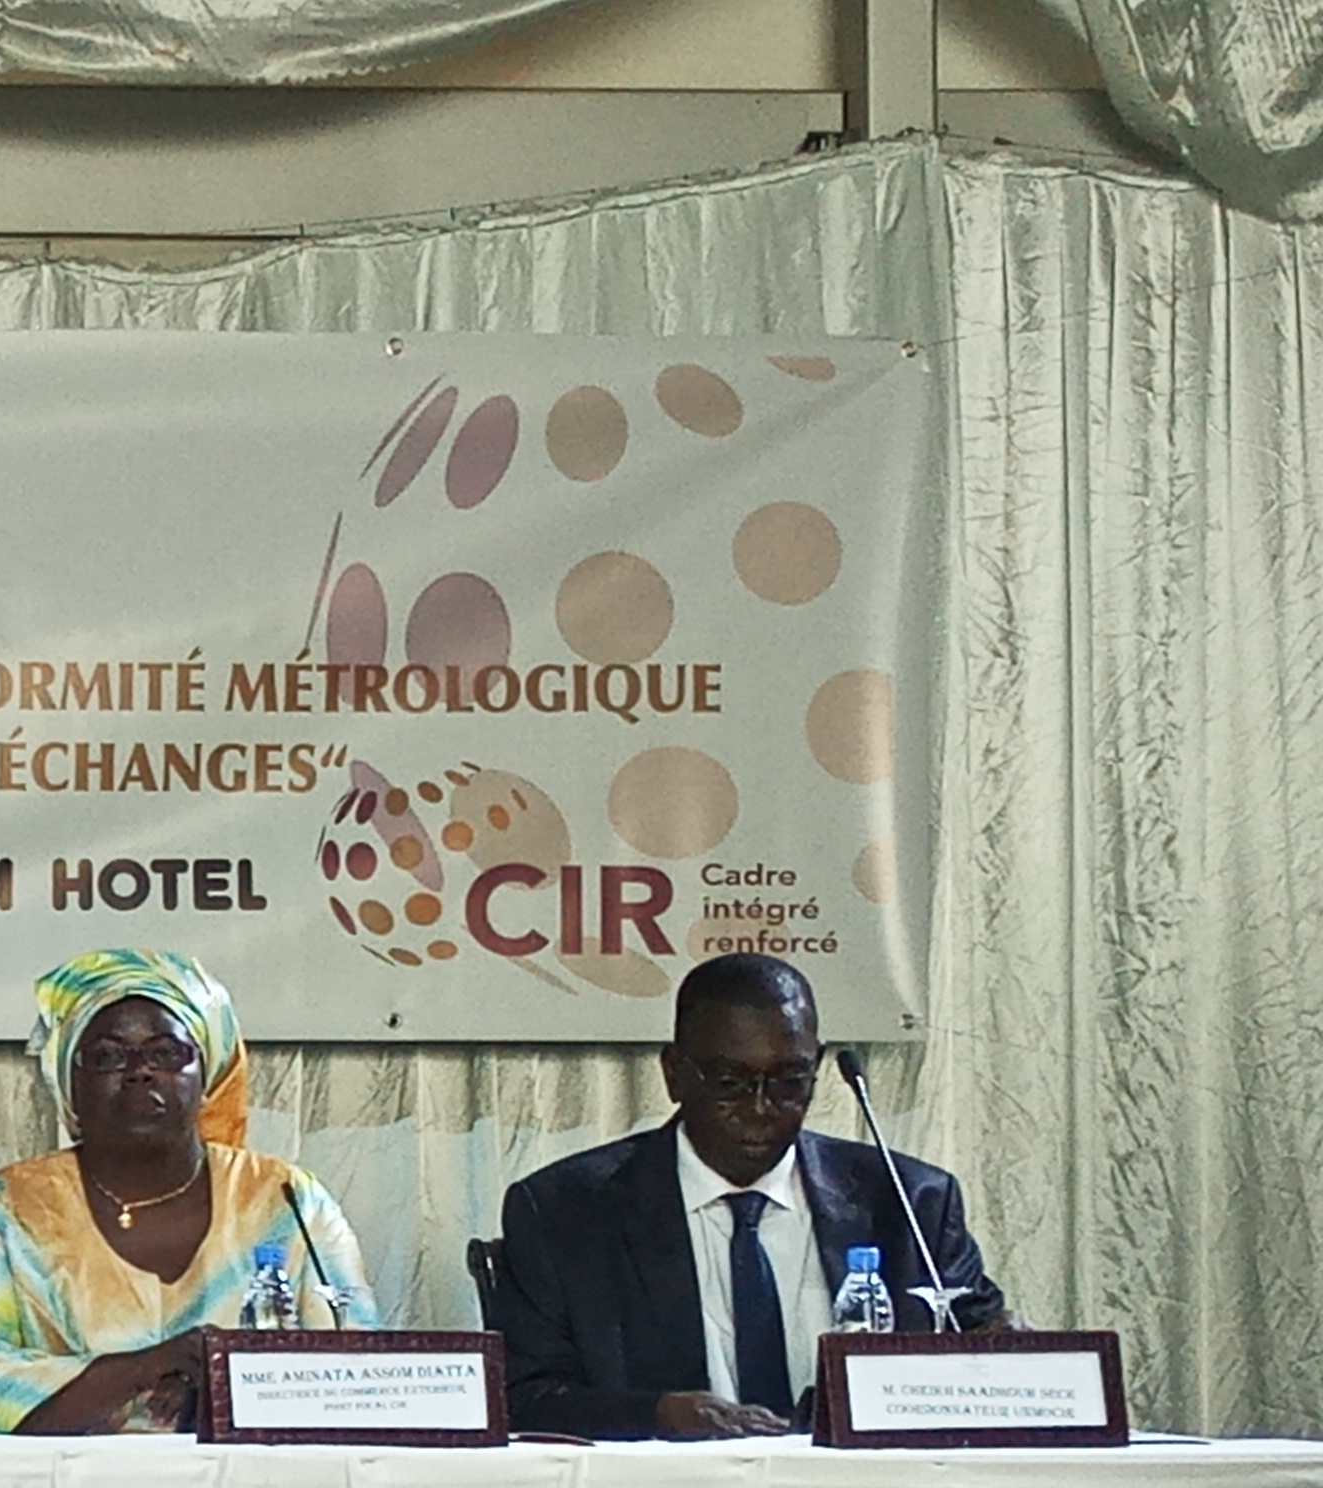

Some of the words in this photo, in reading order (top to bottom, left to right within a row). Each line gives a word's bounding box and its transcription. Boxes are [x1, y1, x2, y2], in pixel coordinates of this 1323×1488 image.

[226, 647, 722, 725] MÉTROLOGIQUE
[54, 860, 268, 911] HOTEL
[700, 863, 797, 887] Cadre
[467, 864, 676, 957] CIR
[702, 896, 819, 926] intégré
[703, 930, 839, 954] renforcé
